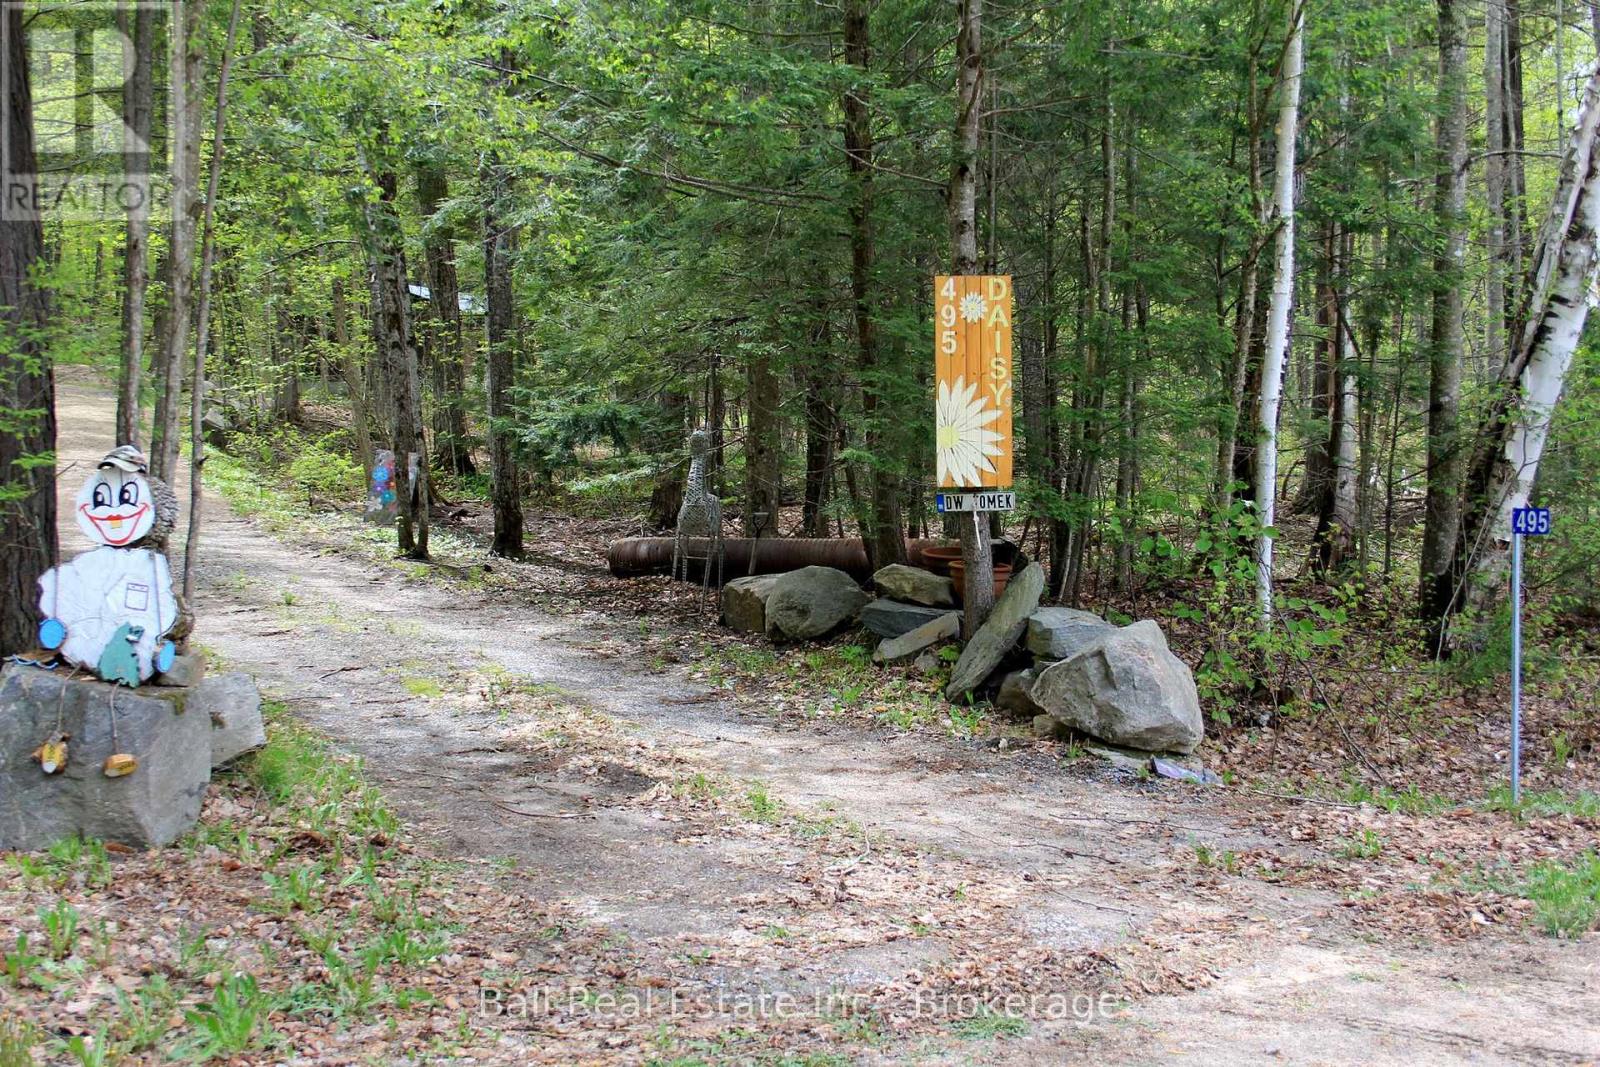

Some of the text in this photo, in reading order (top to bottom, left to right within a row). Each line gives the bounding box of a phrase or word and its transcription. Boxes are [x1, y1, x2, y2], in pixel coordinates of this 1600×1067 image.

[940, 277, 957, 354] 495
[945, 495, 963, 510] DW
[1516, 510, 1548, 533] 495
